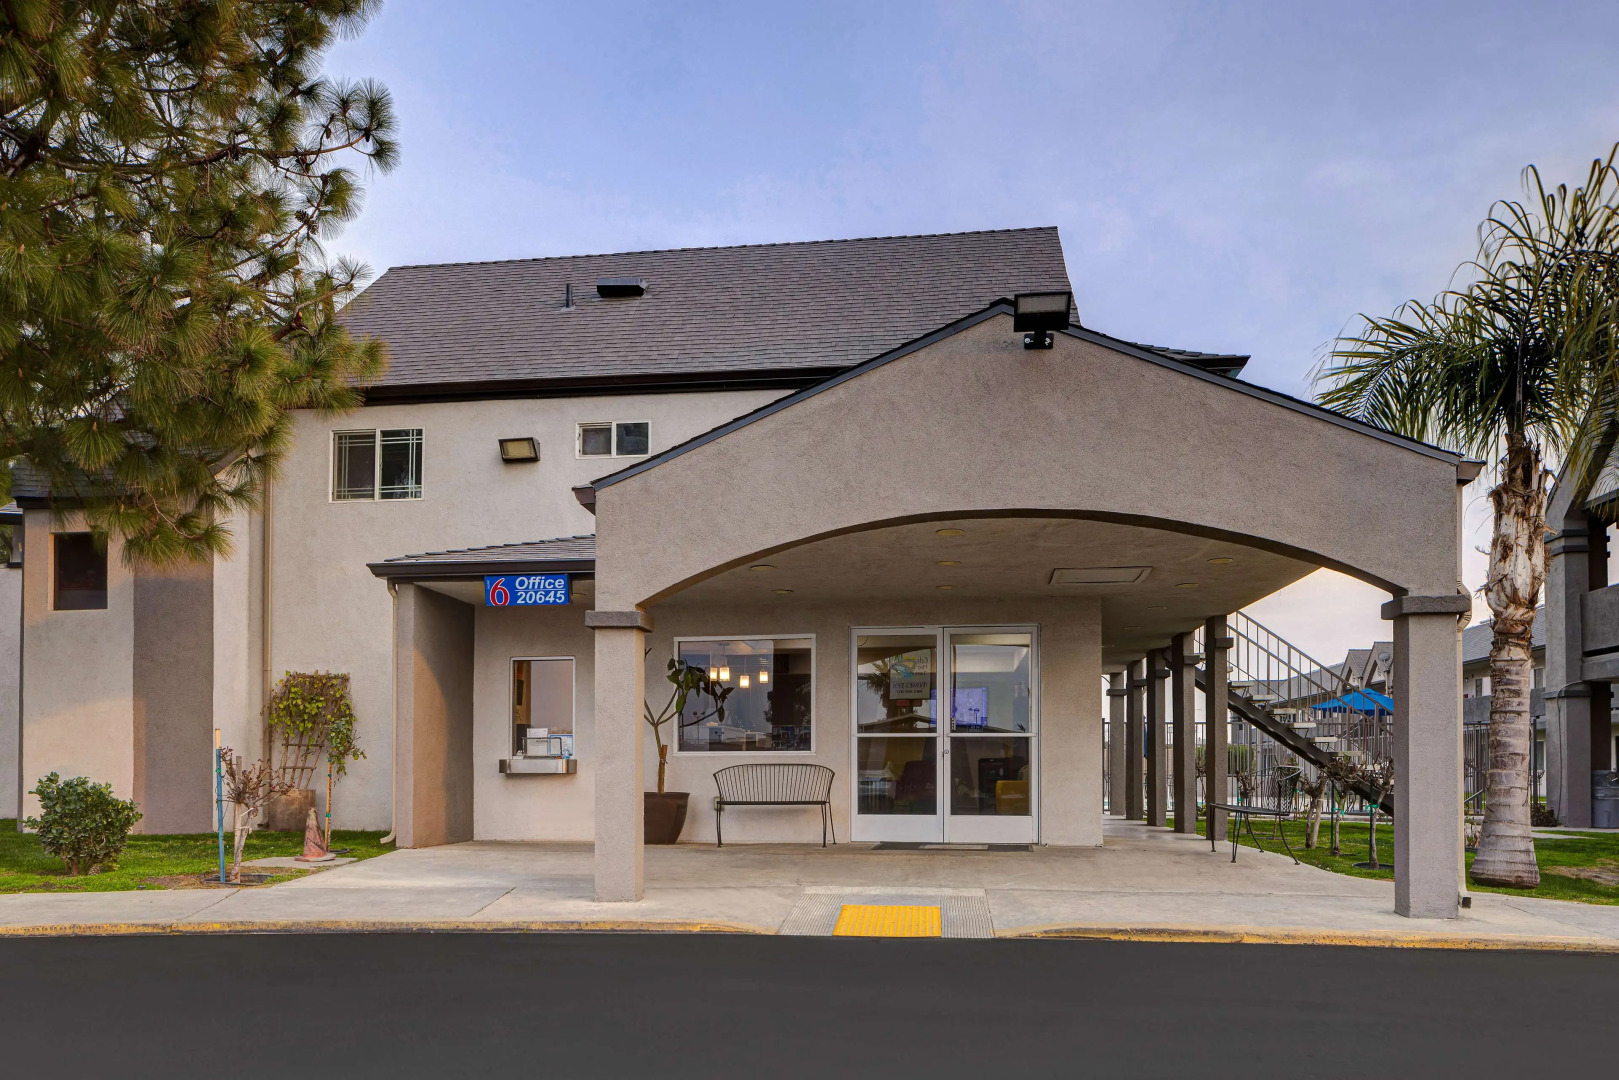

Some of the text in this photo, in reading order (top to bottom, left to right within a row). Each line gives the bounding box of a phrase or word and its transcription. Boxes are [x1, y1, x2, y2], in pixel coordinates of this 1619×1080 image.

[515, 576, 565, 590] Office
[490, 577, 510, 606] 6
[516, 590, 565, 604] 20645
